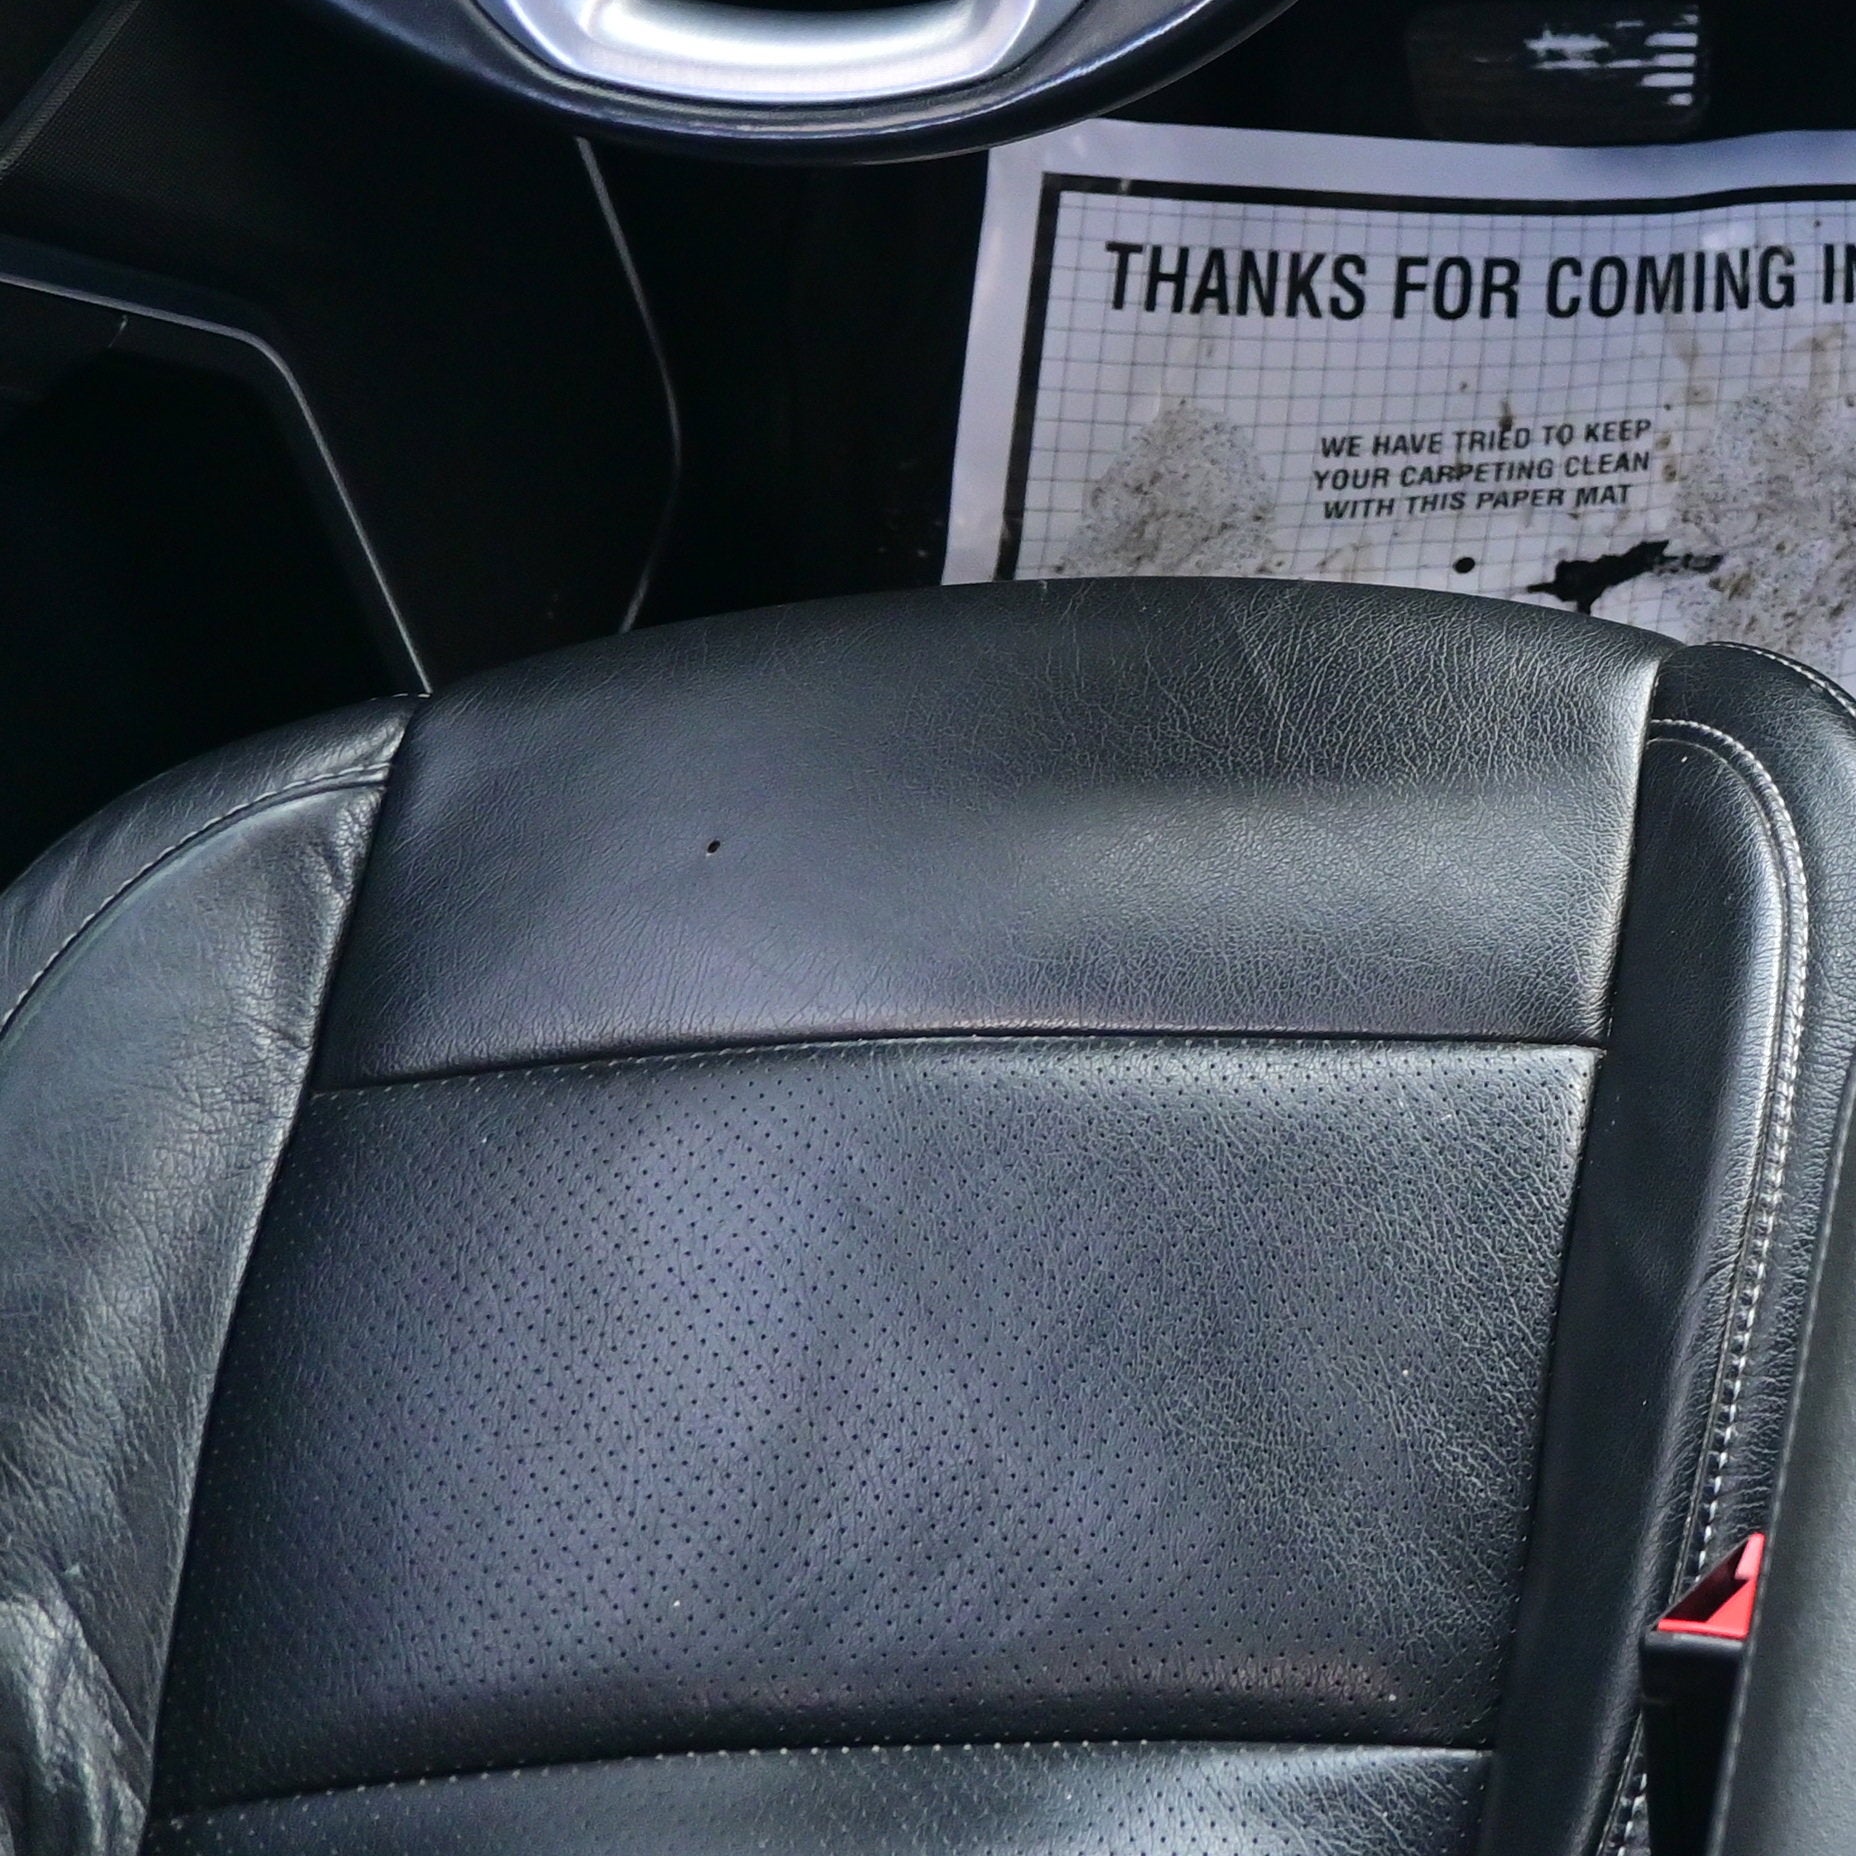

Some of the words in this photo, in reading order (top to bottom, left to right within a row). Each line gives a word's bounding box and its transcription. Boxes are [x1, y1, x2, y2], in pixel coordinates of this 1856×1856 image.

[1105, 240, 1367, 322] THANKS
[1393, 254, 1520, 321] FOR
[1546, 244, 1796, 318] COMING
[1321, 434, 1363, 458] WE
[1372, 431, 1443, 457] HAVE
[1454, 427, 1532, 454] TRIED
[1543, 424, 1574, 447] TO
[1584, 418, 1653, 444] KEEP
[1313, 466, 1390, 491] YOUR
[1400, 458, 1554, 489] CARPETING
[1564, 451, 1651, 478] CLEAN
[1323, 497, 1396, 521] WITH
[1406, 491, 1467, 516] THIS
[1475, 486, 1567, 510] PAPER
[1574, 483, 1634, 508] MAT
